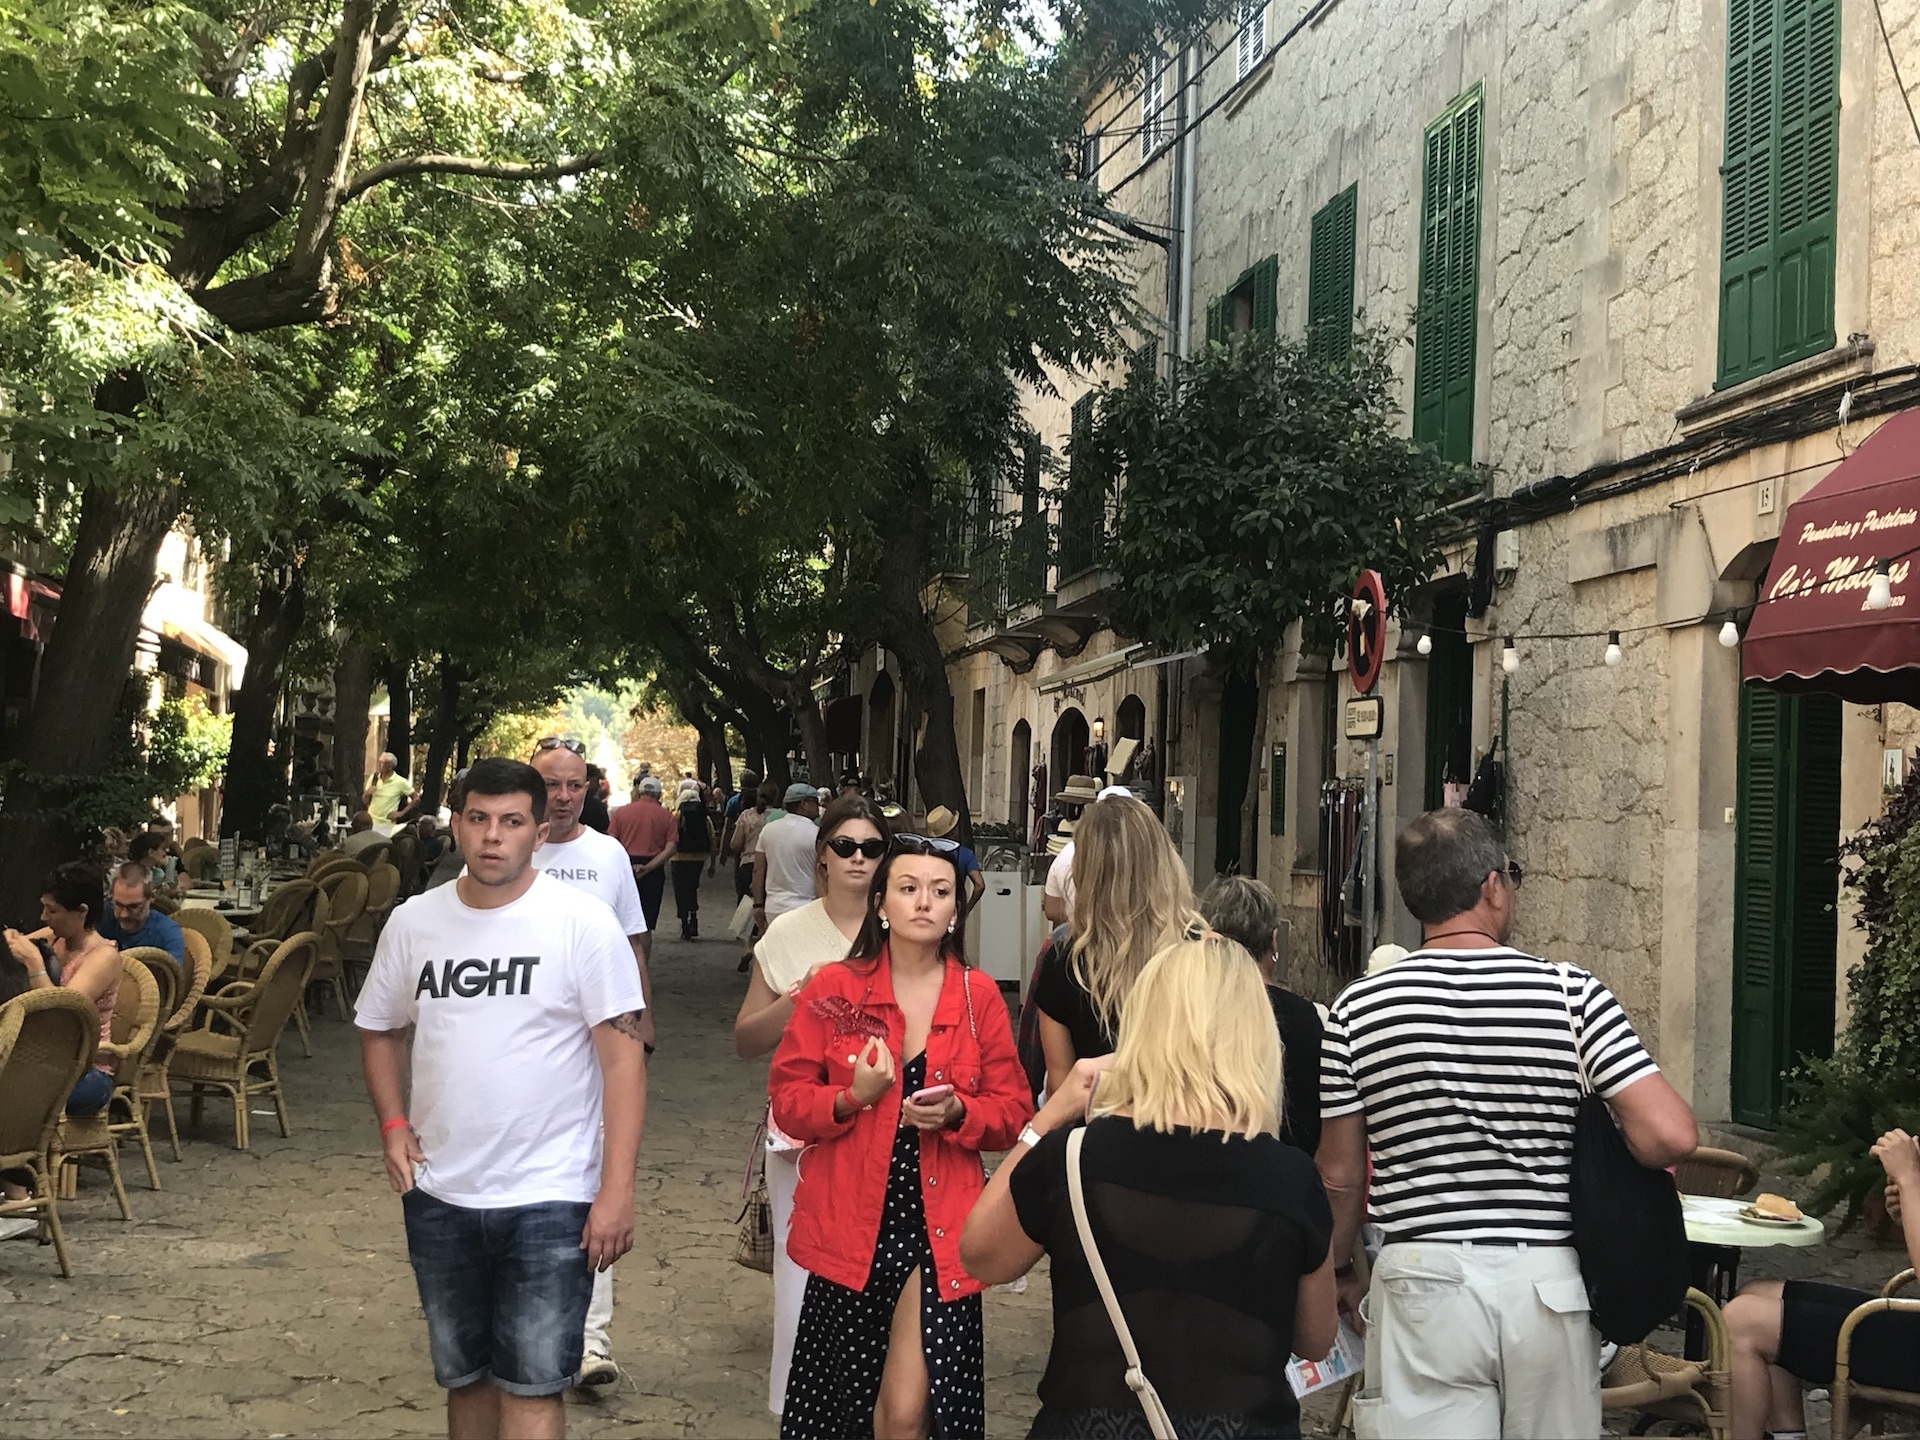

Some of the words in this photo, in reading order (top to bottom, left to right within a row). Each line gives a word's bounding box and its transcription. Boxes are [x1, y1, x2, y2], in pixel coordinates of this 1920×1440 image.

[1849, 522, 1861, 540] y
[1820, 555, 1910, 594] Molias
[415, 956, 541, 1000] AIGHT
